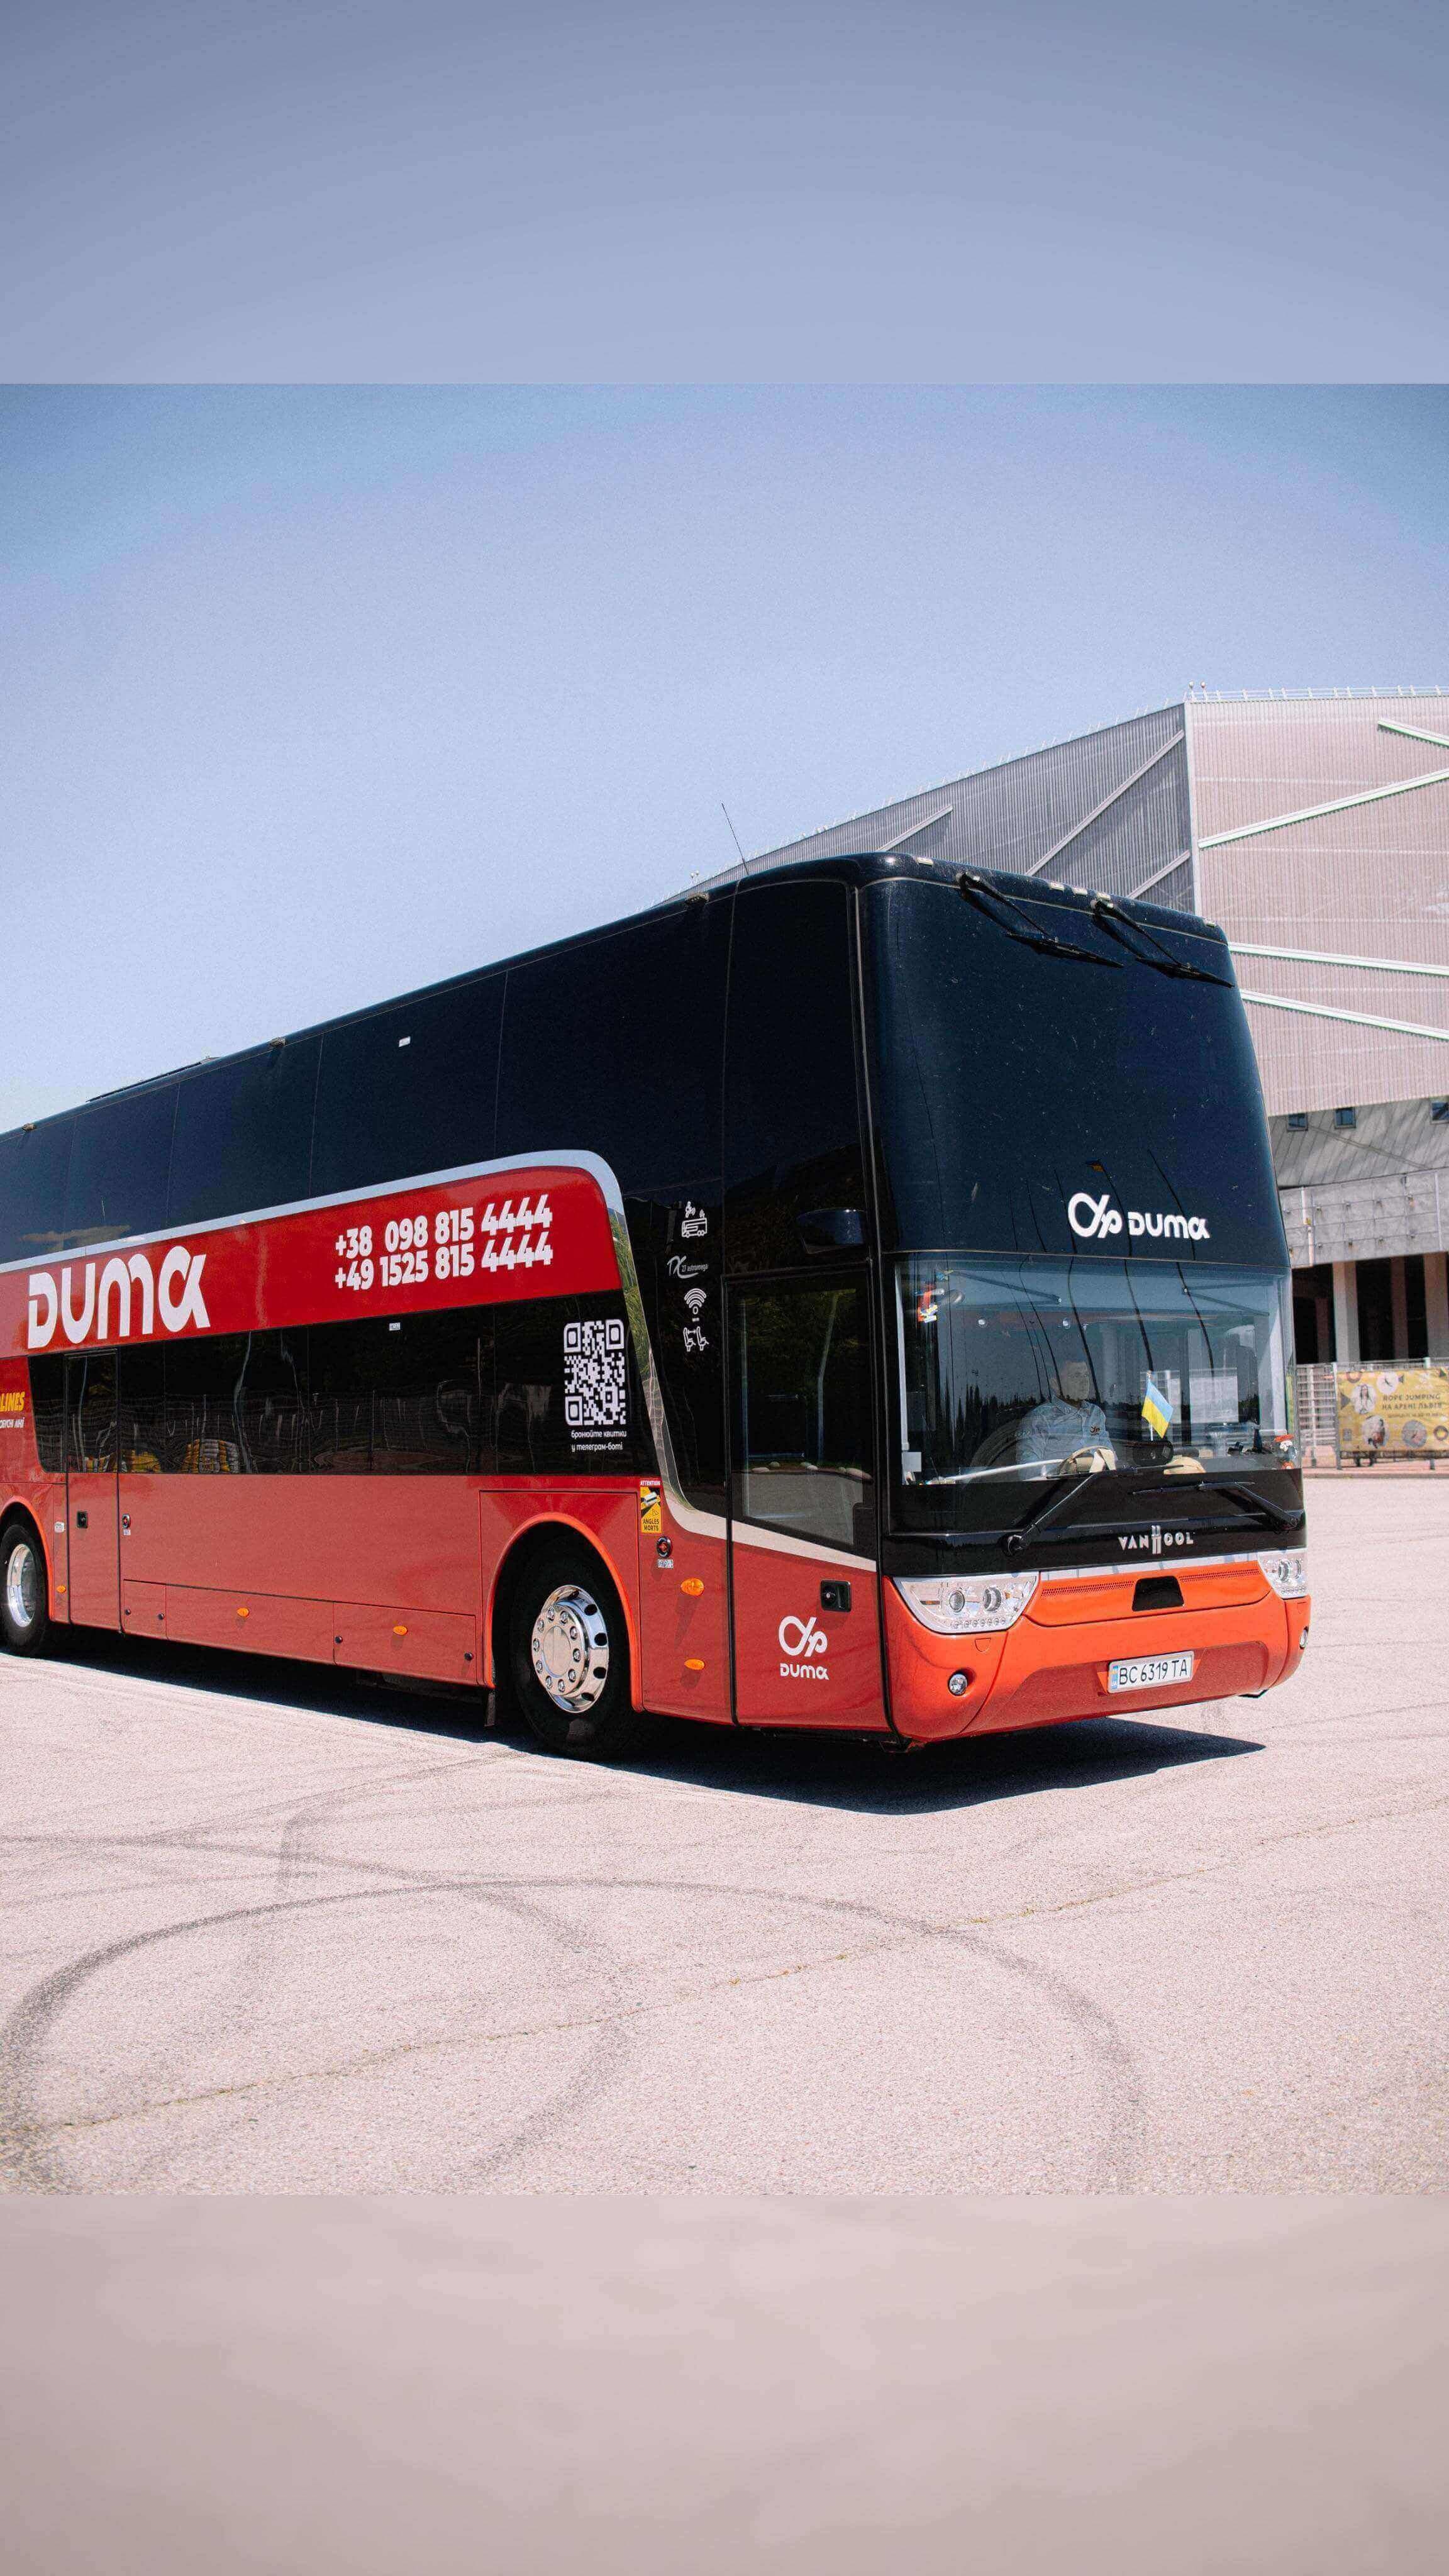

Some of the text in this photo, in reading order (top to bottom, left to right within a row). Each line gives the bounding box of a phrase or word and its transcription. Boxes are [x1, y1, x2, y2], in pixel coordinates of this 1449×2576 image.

[335, 1194, 553, 1259] +38 098 815 4444
[335, 1231, 553, 1291] +49 1525 815 4444
[0, 1392, 25, 1412] LINES
[1118, 1535, 1149, 1550] VAN
[1119, 1659, 1187, 1685] BC 6319 TA
